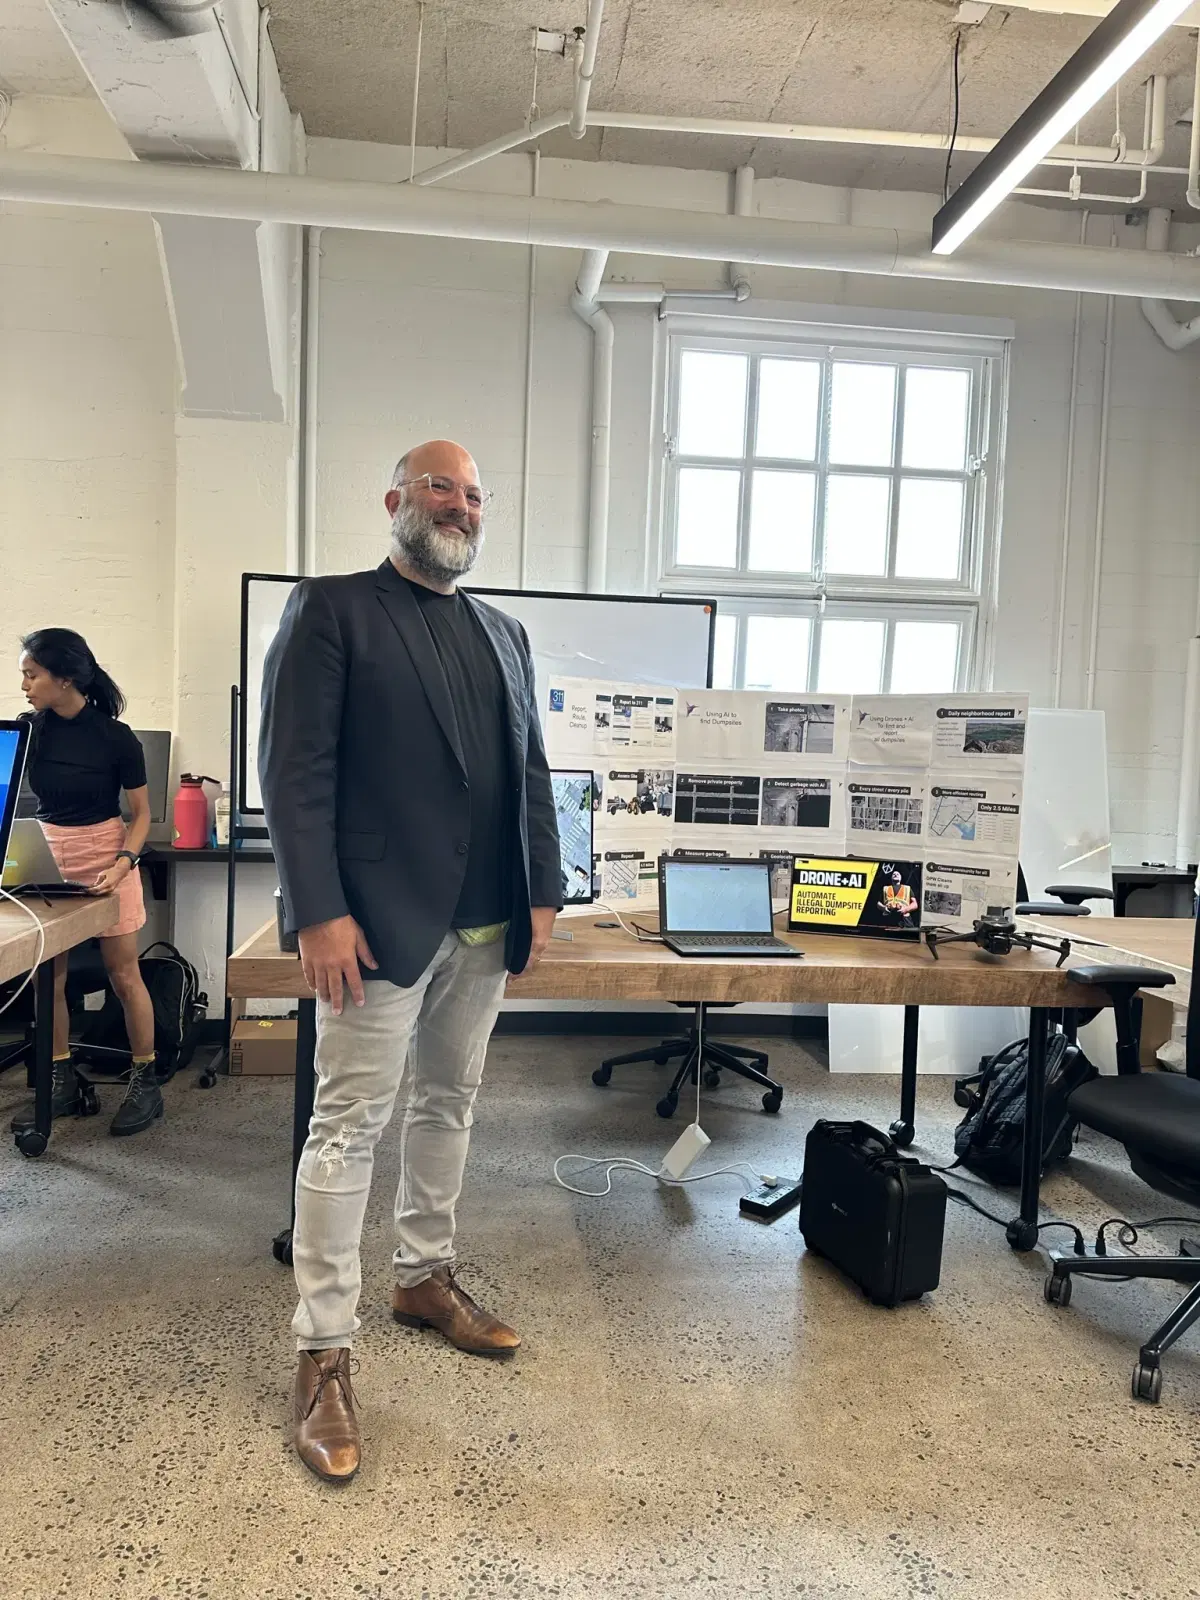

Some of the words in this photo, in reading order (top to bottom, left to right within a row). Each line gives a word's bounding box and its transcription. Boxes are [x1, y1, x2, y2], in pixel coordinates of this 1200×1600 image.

[553, 690, 564, 702] 311
[800, 870, 862, 888] DRONE+AI
[797, 890, 836, 900] AUTOMATE
[796, 899, 824, 907] ILLEGAL
[825, 900, 862, 910] DUMPSITE
[796, 906, 836, 916] REPORTING
